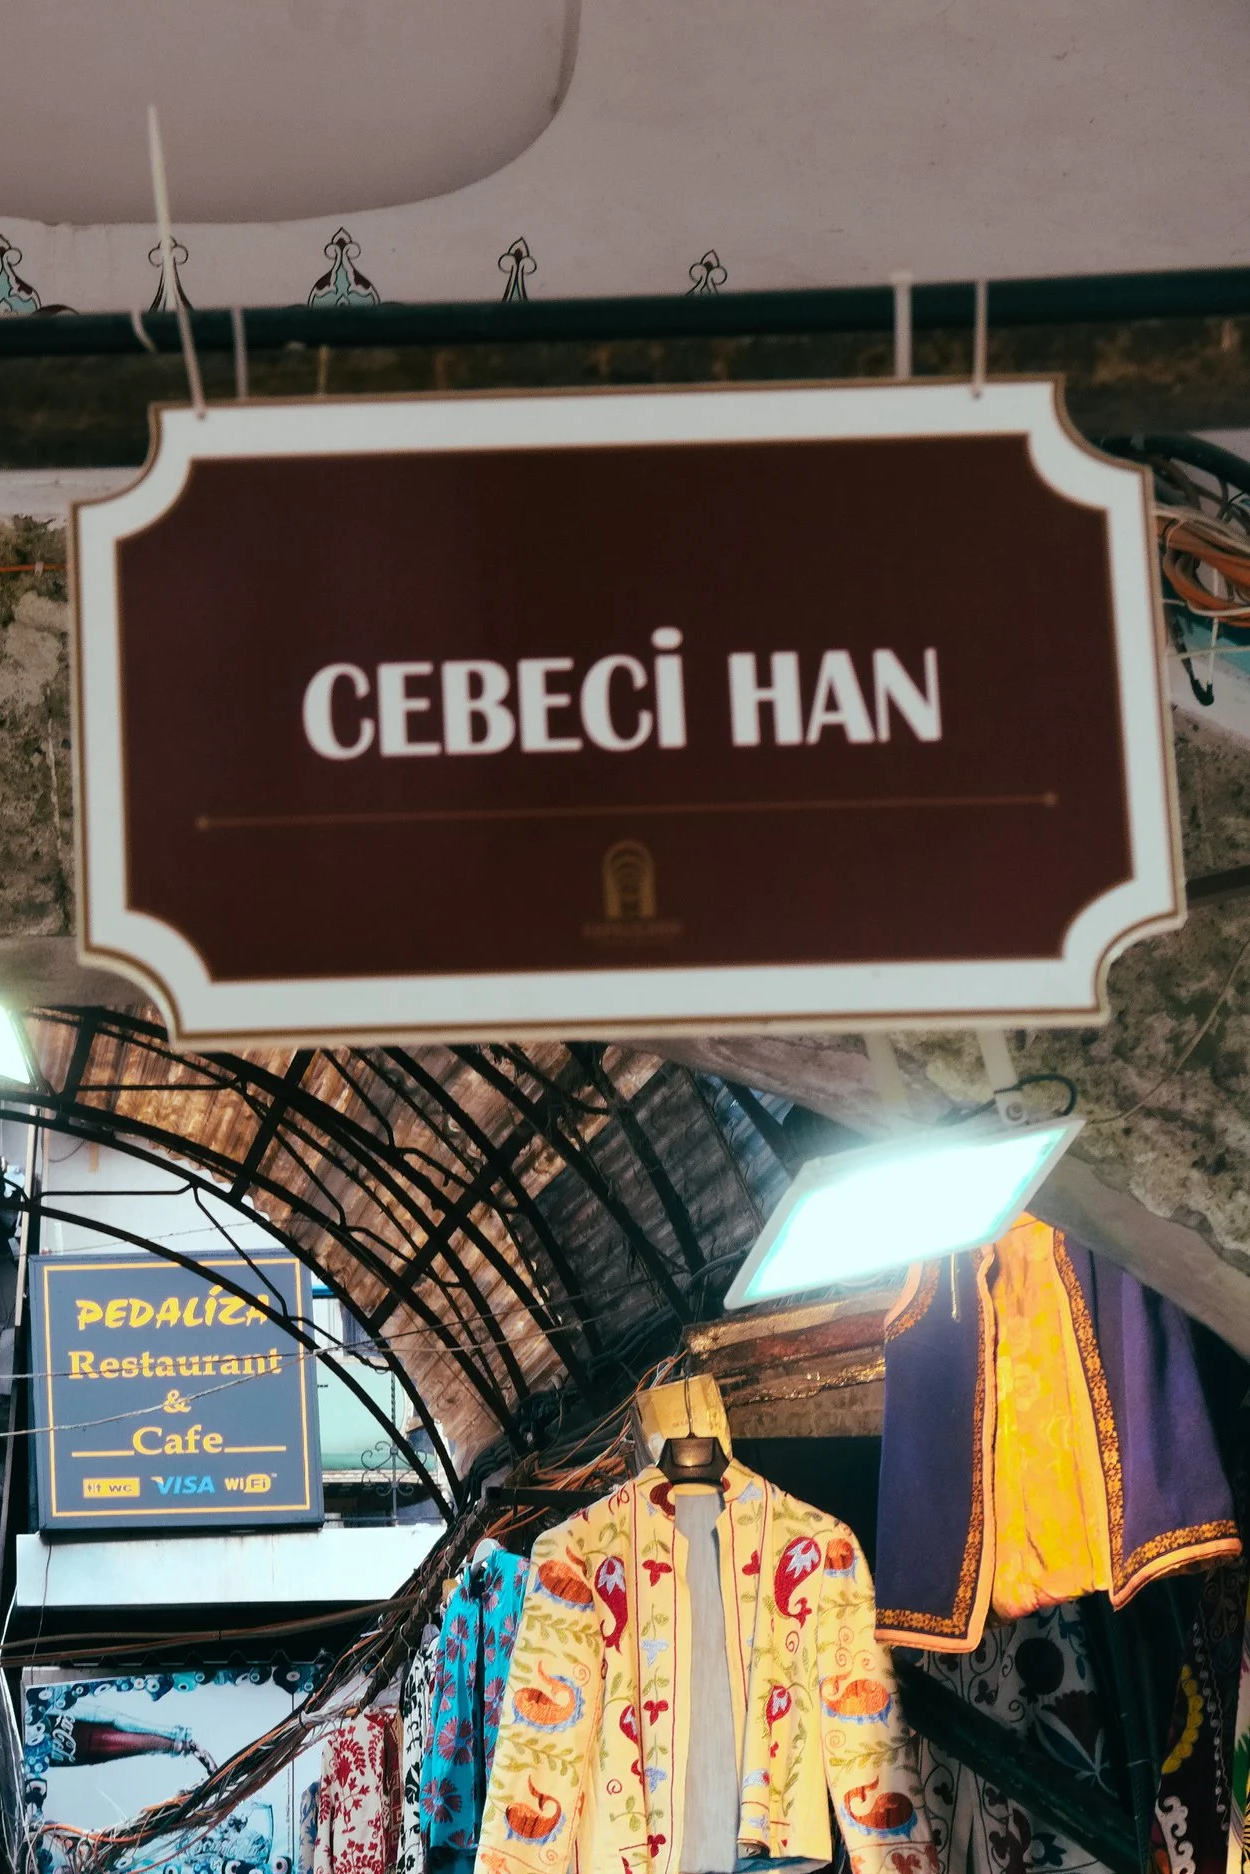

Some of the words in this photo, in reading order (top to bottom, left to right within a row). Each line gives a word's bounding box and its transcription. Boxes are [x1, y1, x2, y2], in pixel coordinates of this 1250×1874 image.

[728, 648, 942, 747] HAN
[68, 1348, 283, 1380] Restaurant
[163, 1389, 192, 1413] &
[132, 1425, 223, 1455] Cafe
[109, 1484, 132, 1493] WC
[151, 1474, 216, 1495] VISA
